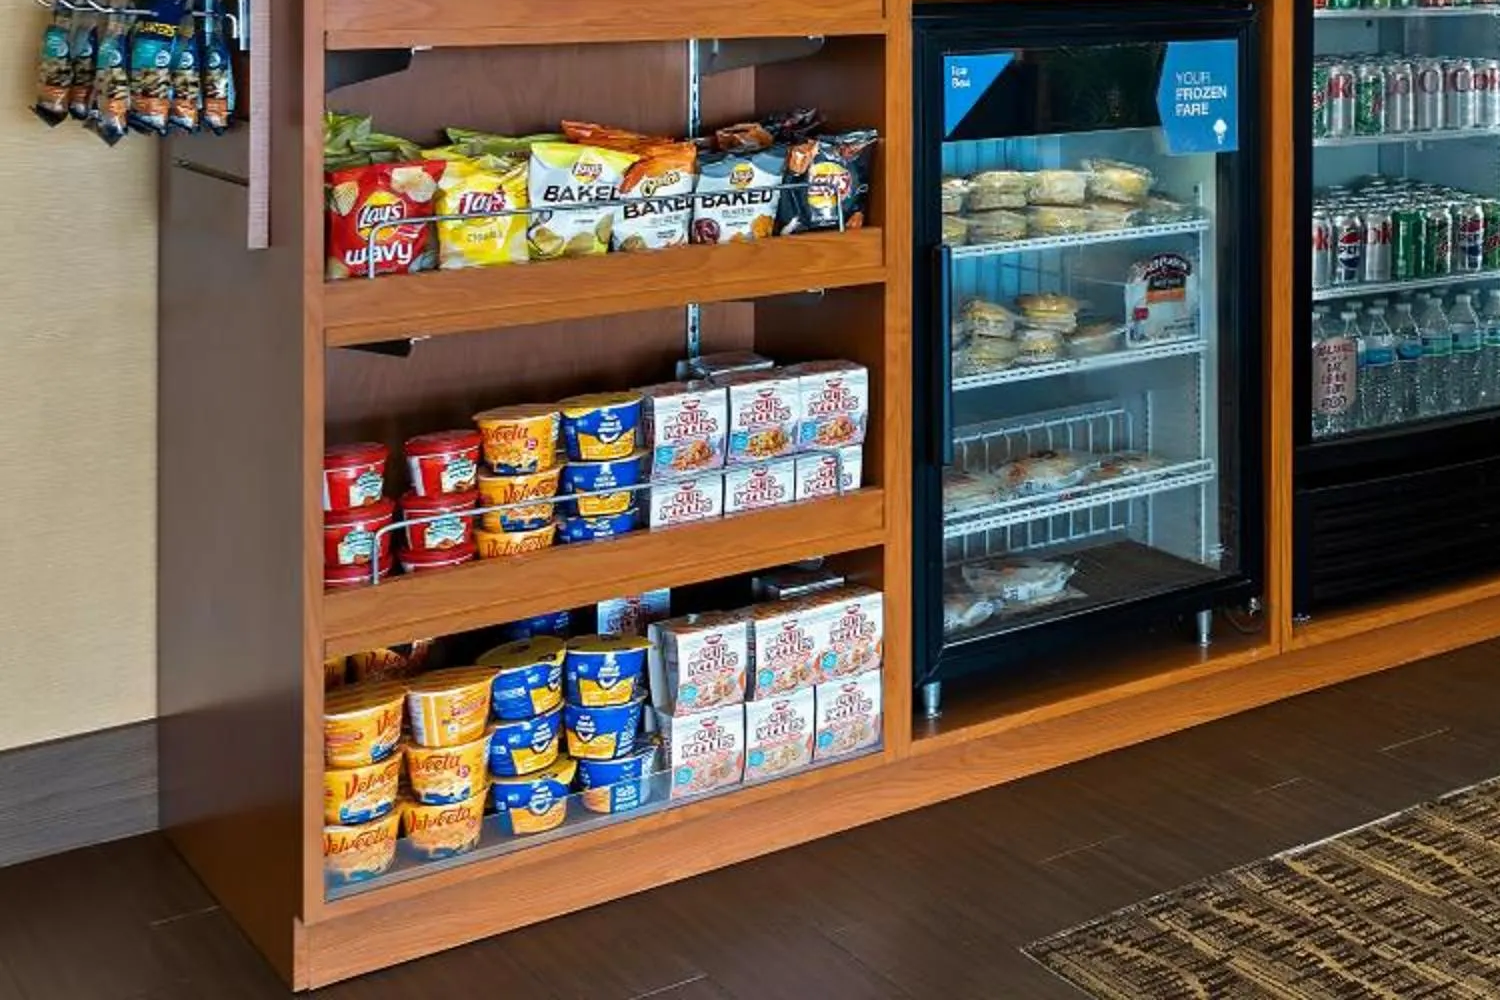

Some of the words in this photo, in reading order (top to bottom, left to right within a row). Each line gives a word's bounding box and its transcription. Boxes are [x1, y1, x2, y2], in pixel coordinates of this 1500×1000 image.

[1175, 71, 1211, 85] YOUR
[1175, 86, 1227, 101] FROZEN
[1175, 103, 1209, 117] FARE
[543, 183, 620, 203] BAKED
[701, 188, 773, 209] BAKED
[624, 197, 693, 220] BAKED
[345, 241, 413, 266] wavy
